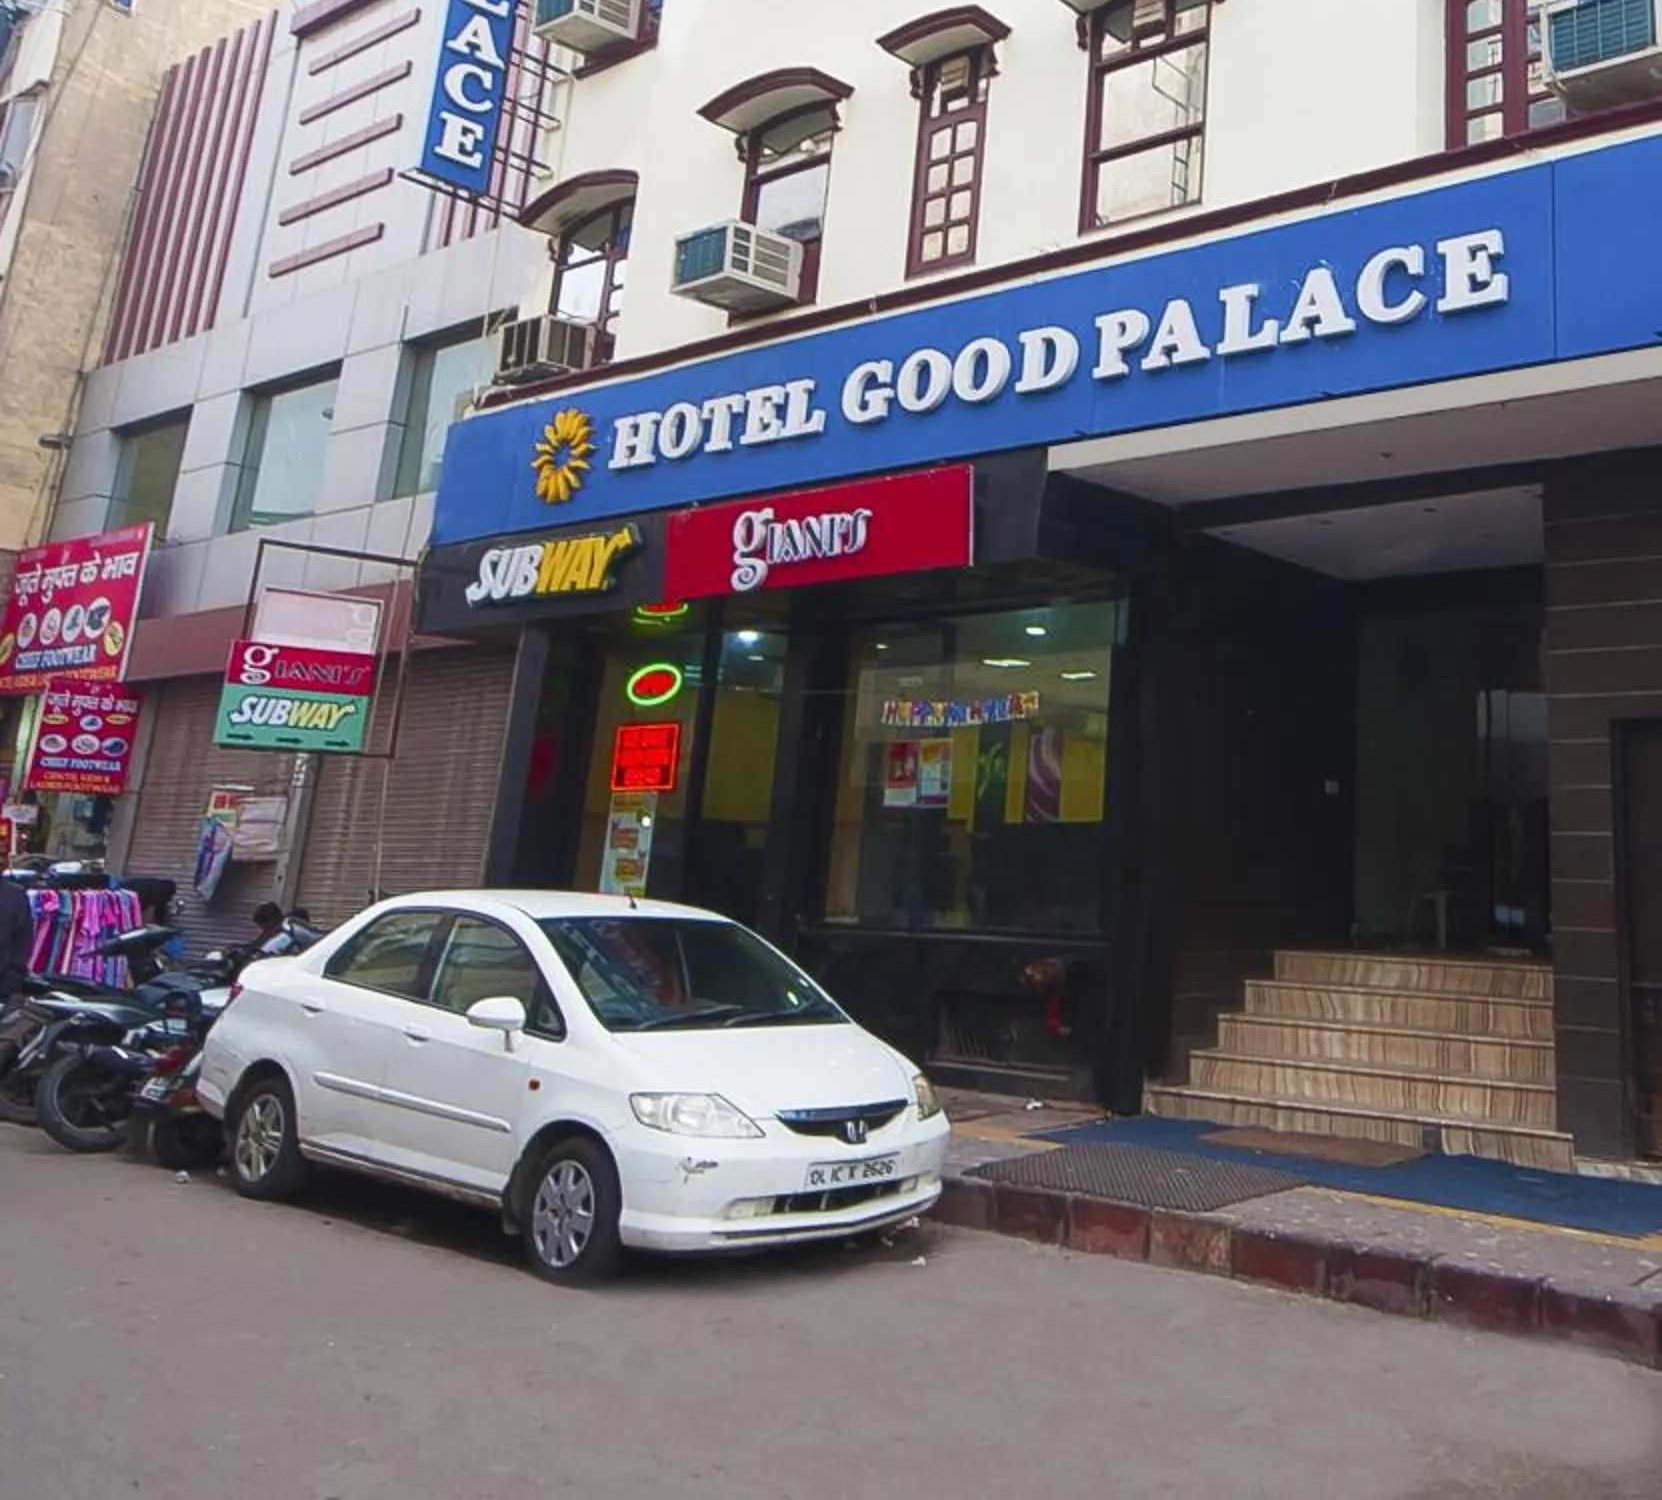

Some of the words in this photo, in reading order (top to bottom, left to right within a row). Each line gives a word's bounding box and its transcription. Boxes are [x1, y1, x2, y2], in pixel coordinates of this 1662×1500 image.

[607, 378, 825, 472] HOTEL
[840, 325, 1080, 425] GOOD
[1092, 229, 1508, 381] PALACE
[466, 525, 638, 606] SUBWAY
[228, 695, 357, 732] SUBWAY
